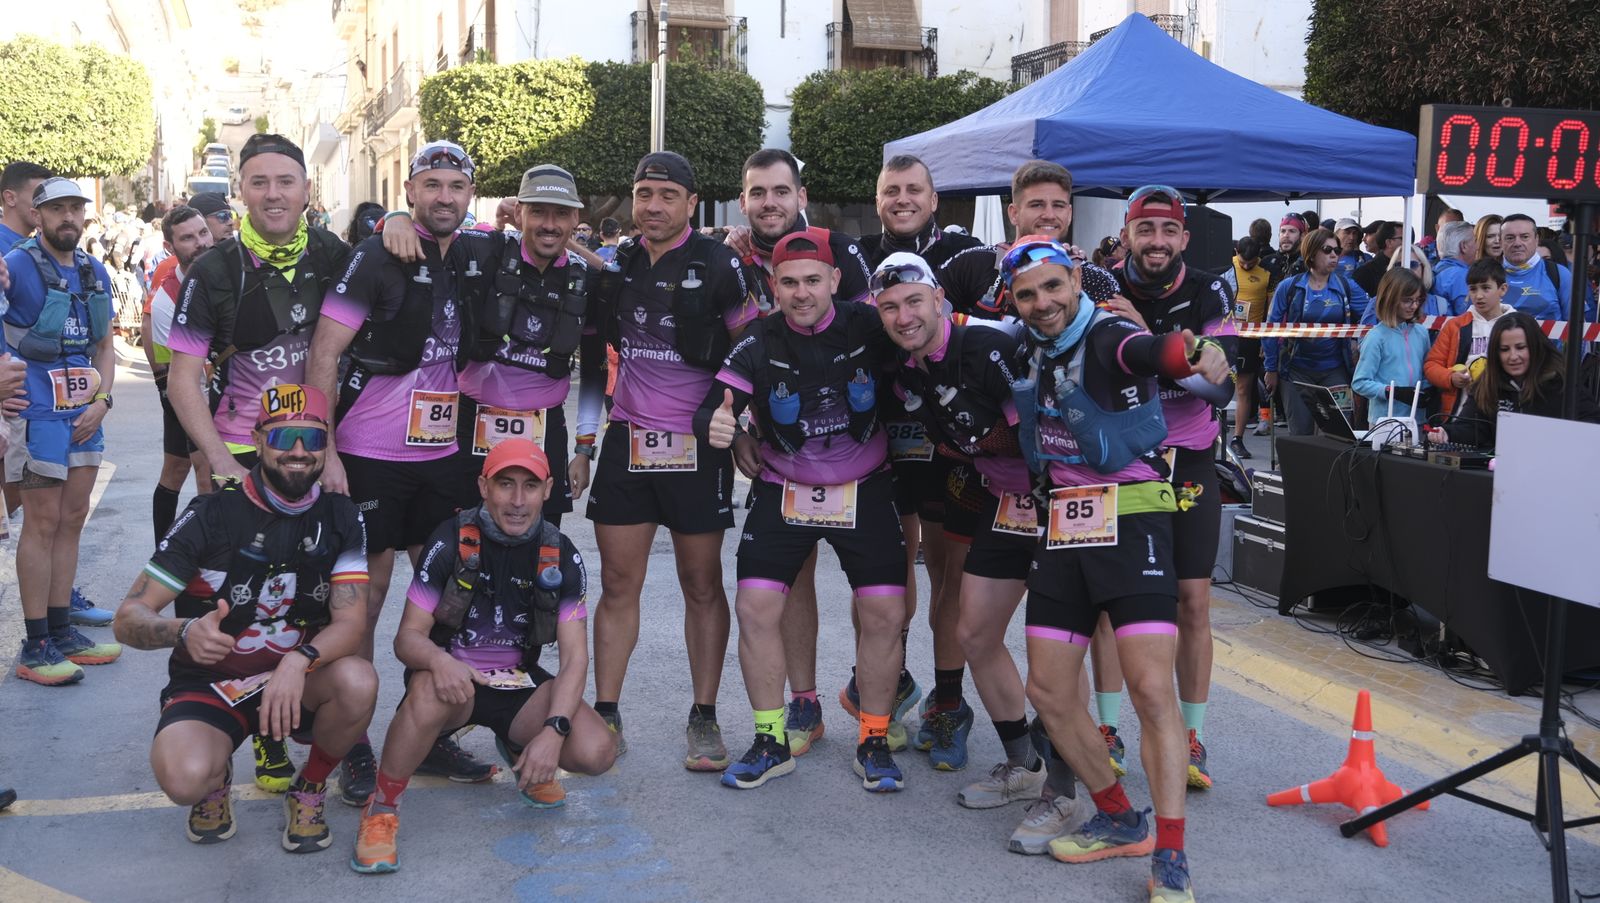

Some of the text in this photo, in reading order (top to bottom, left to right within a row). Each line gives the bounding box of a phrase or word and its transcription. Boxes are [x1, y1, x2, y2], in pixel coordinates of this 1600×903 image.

[535, 185, 570, 194] SALOMON
[343, 250, 365, 283] Espabrok
[182, 278, 196, 313] Espabrok
[291, 348, 308, 366] pri
[511, 352, 548, 367] prima
[631, 347, 685, 362] primaflo
[69, 377, 88, 392] 59
[1121, 385, 1142, 410] pri
[430, 404, 453, 422] 84
[494, 418, 525, 435] 90
[888, 425, 925, 440] 382
[645, 431, 673, 448] 81
[811, 486, 826, 503] 3
[1065, 499, 1094, 520] 85
